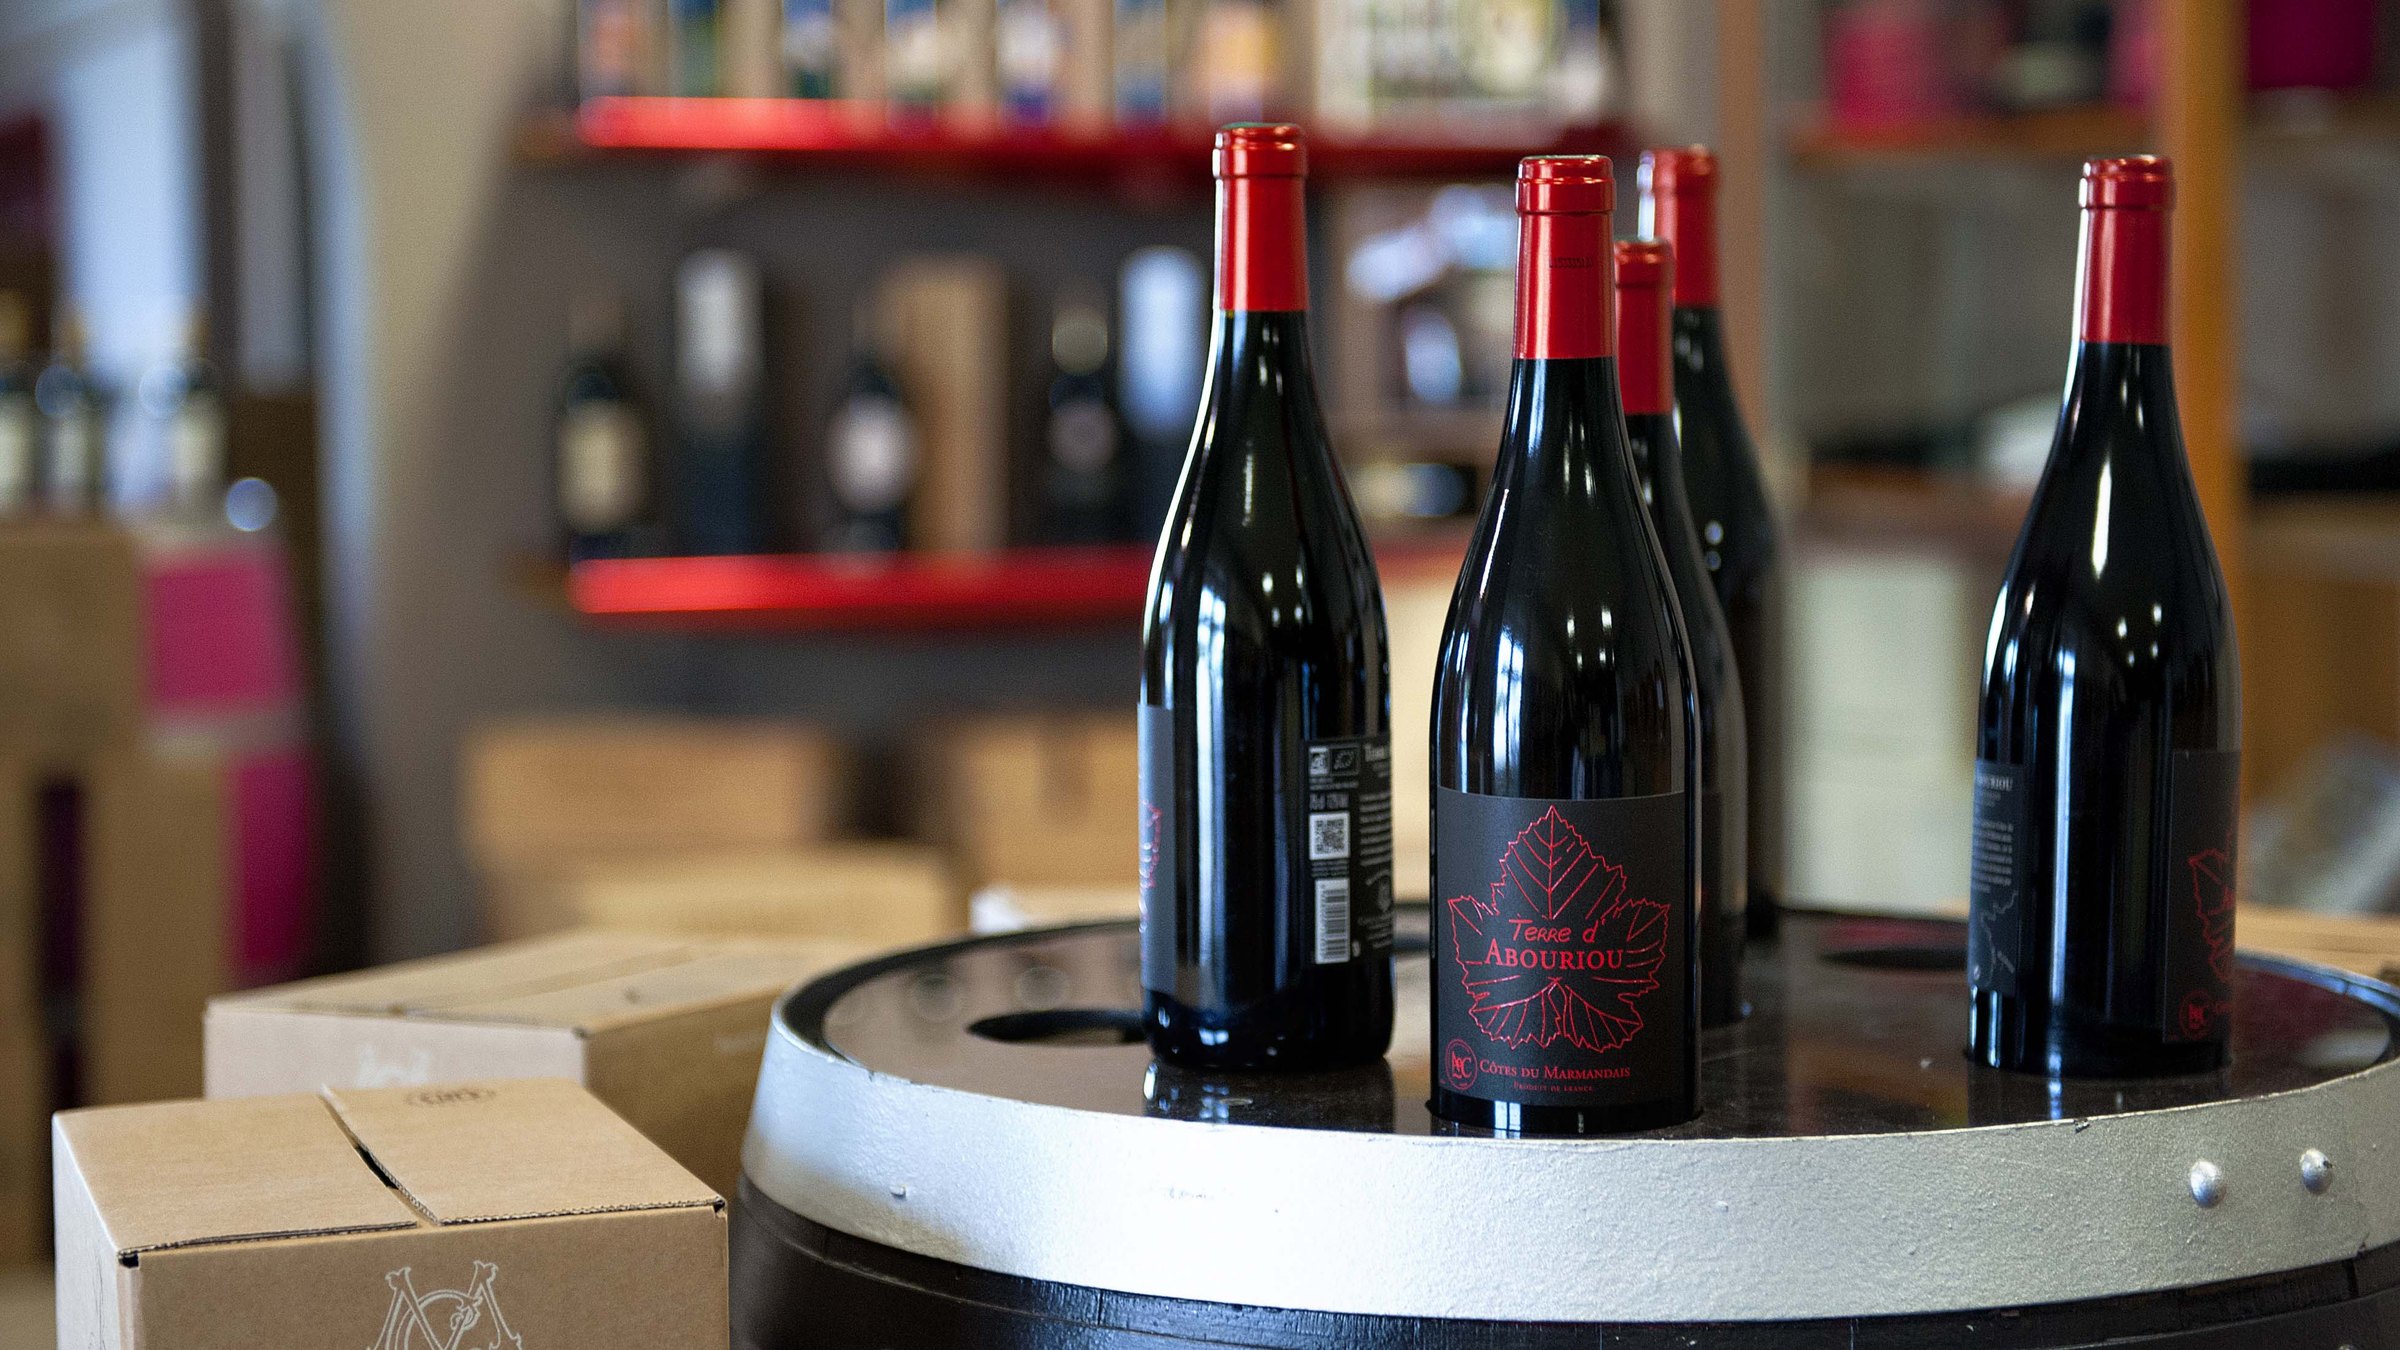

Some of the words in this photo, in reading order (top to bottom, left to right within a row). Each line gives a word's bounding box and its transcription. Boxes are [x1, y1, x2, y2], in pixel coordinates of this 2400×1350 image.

[1485, 937, 1624, 970] ABOURIOU
[1479, 1058, 1517, 1077] CÔTES
[1520, 1066, 1540, 1079] DU
[1543, 1064, 1631, 1080] MARMANDAIS
